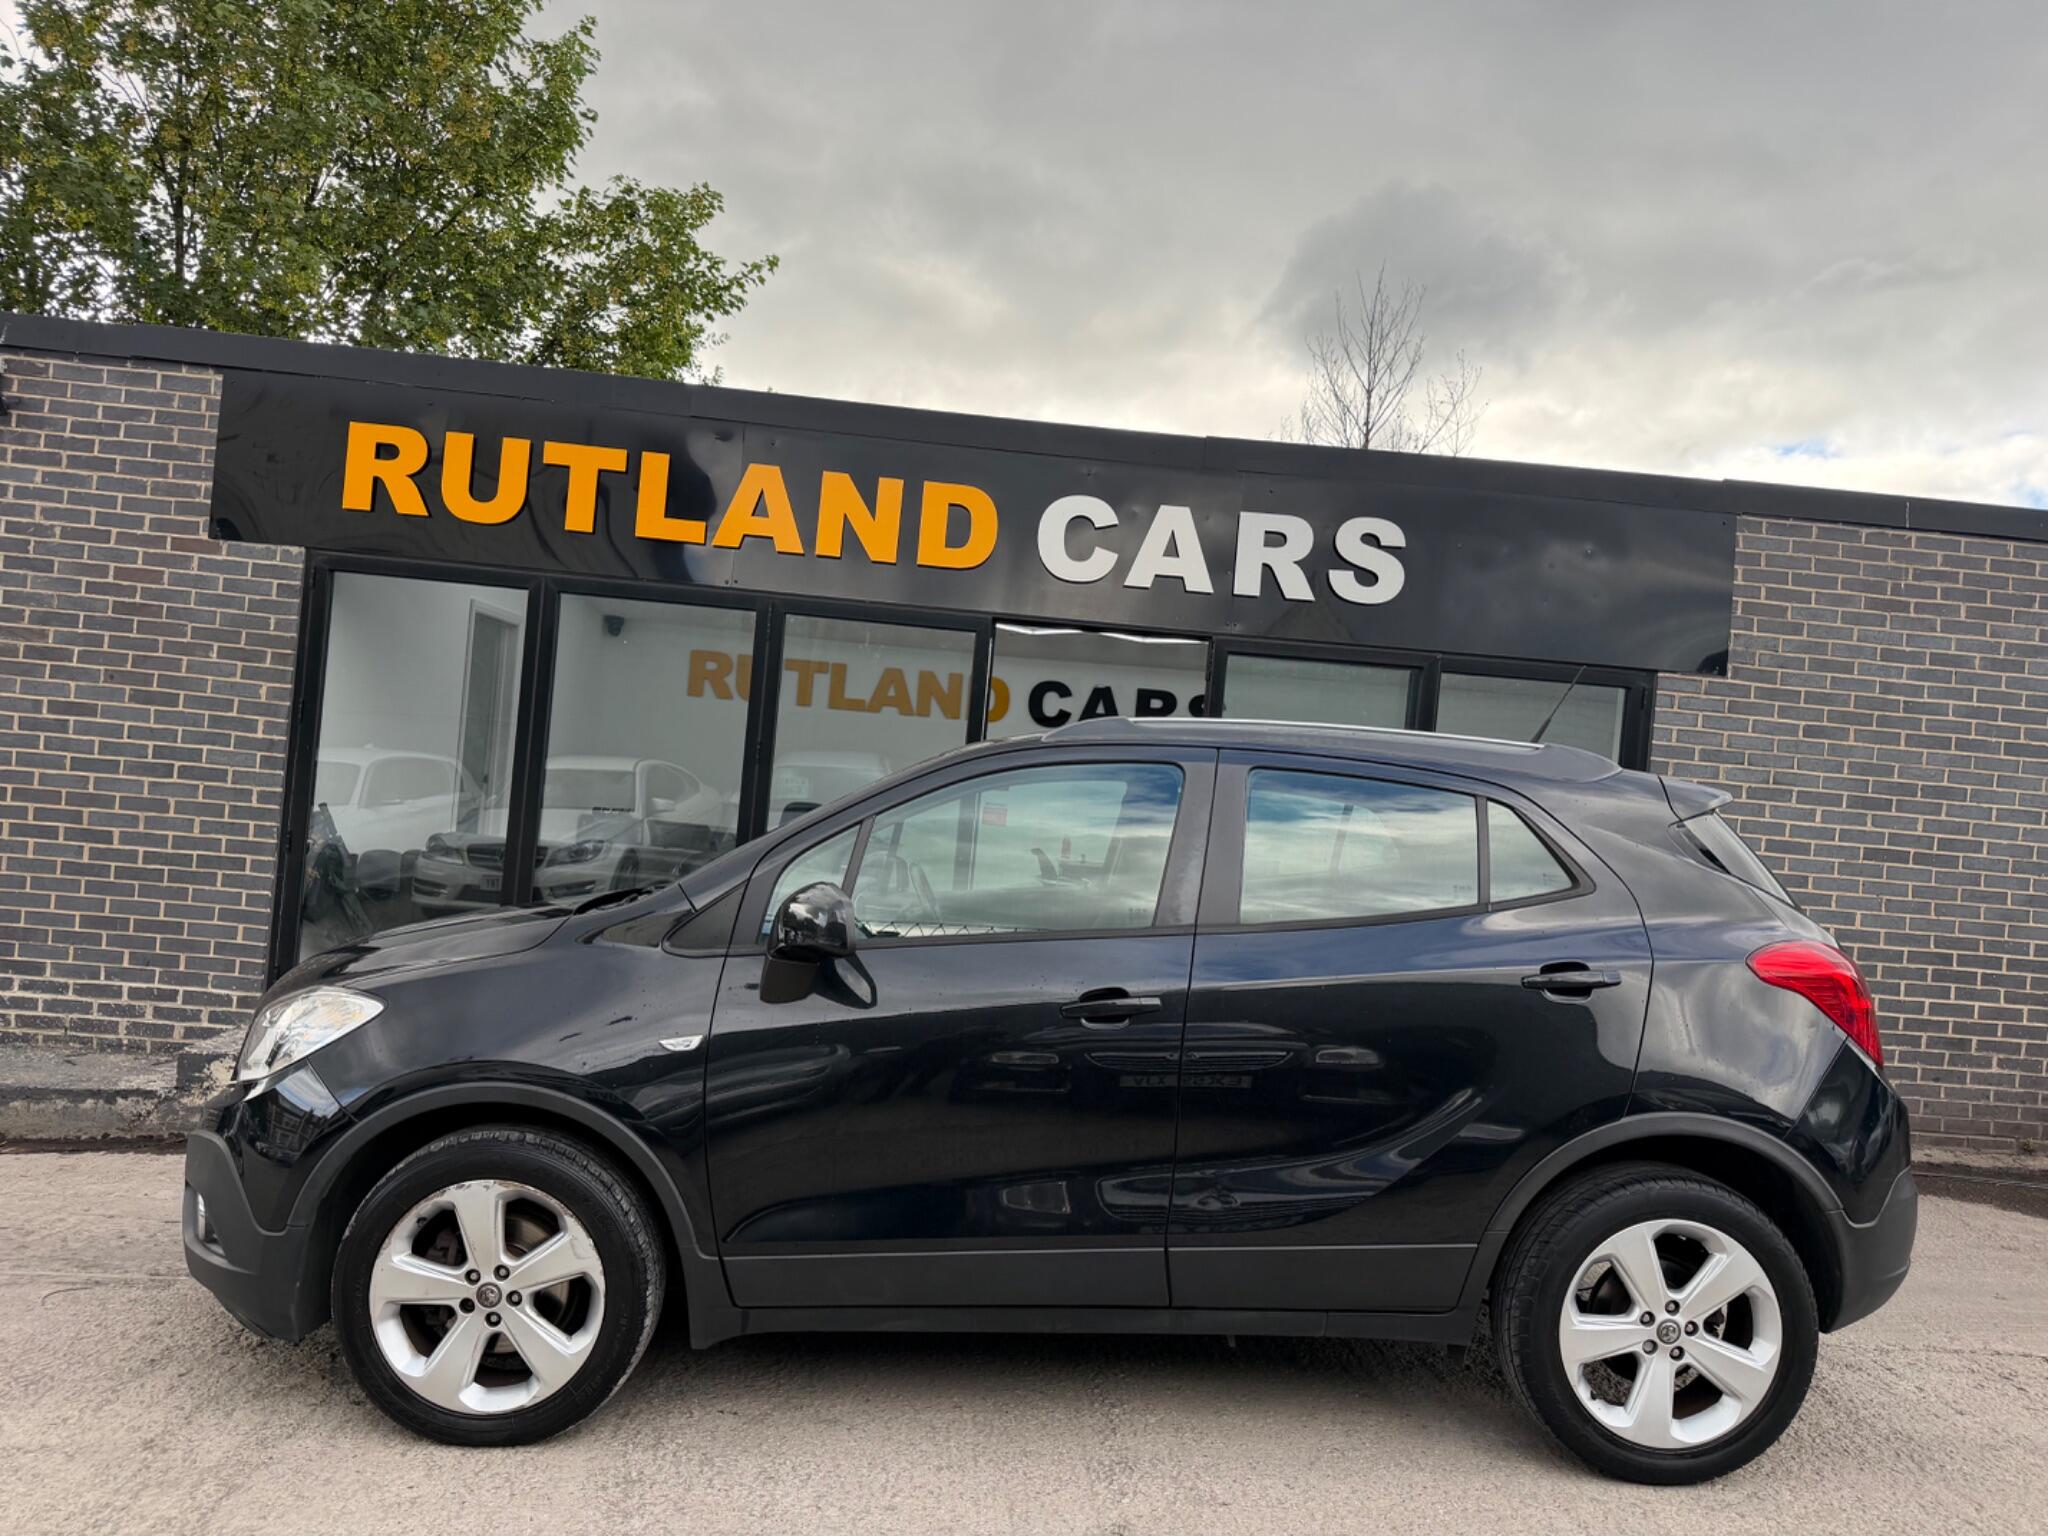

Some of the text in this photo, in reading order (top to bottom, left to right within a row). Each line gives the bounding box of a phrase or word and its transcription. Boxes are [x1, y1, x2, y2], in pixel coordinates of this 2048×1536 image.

[342, 421, 1407, 605] RUTLAND CARS
[1028, 680, 1225, 729] CAR
